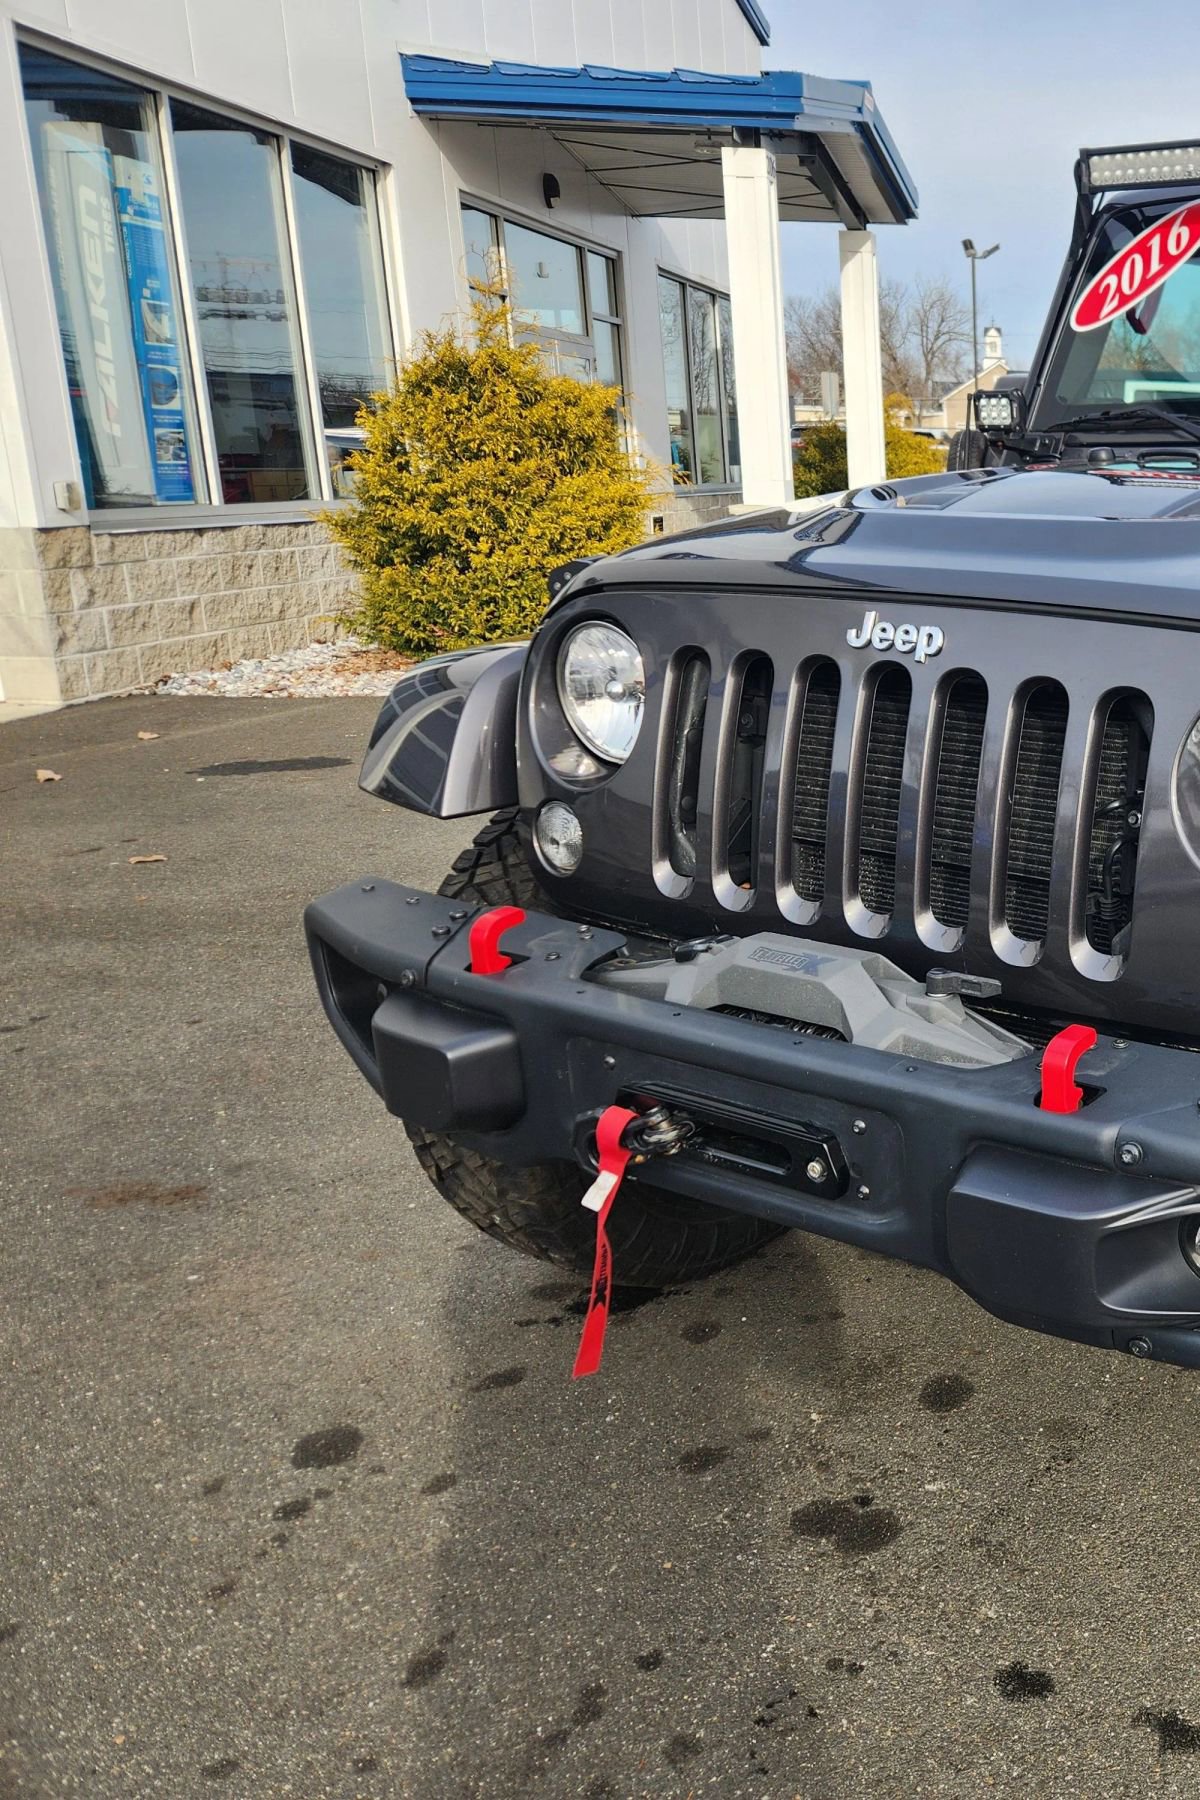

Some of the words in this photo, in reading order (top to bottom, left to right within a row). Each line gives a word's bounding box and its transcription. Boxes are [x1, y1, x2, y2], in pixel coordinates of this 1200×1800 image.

[101, 195, 115, 253] TIRES
[1099, 210, 1190, 320] 2016
[78, 184, 121, 437] FALKEN
[846, 610, 945, 664] Jeep
